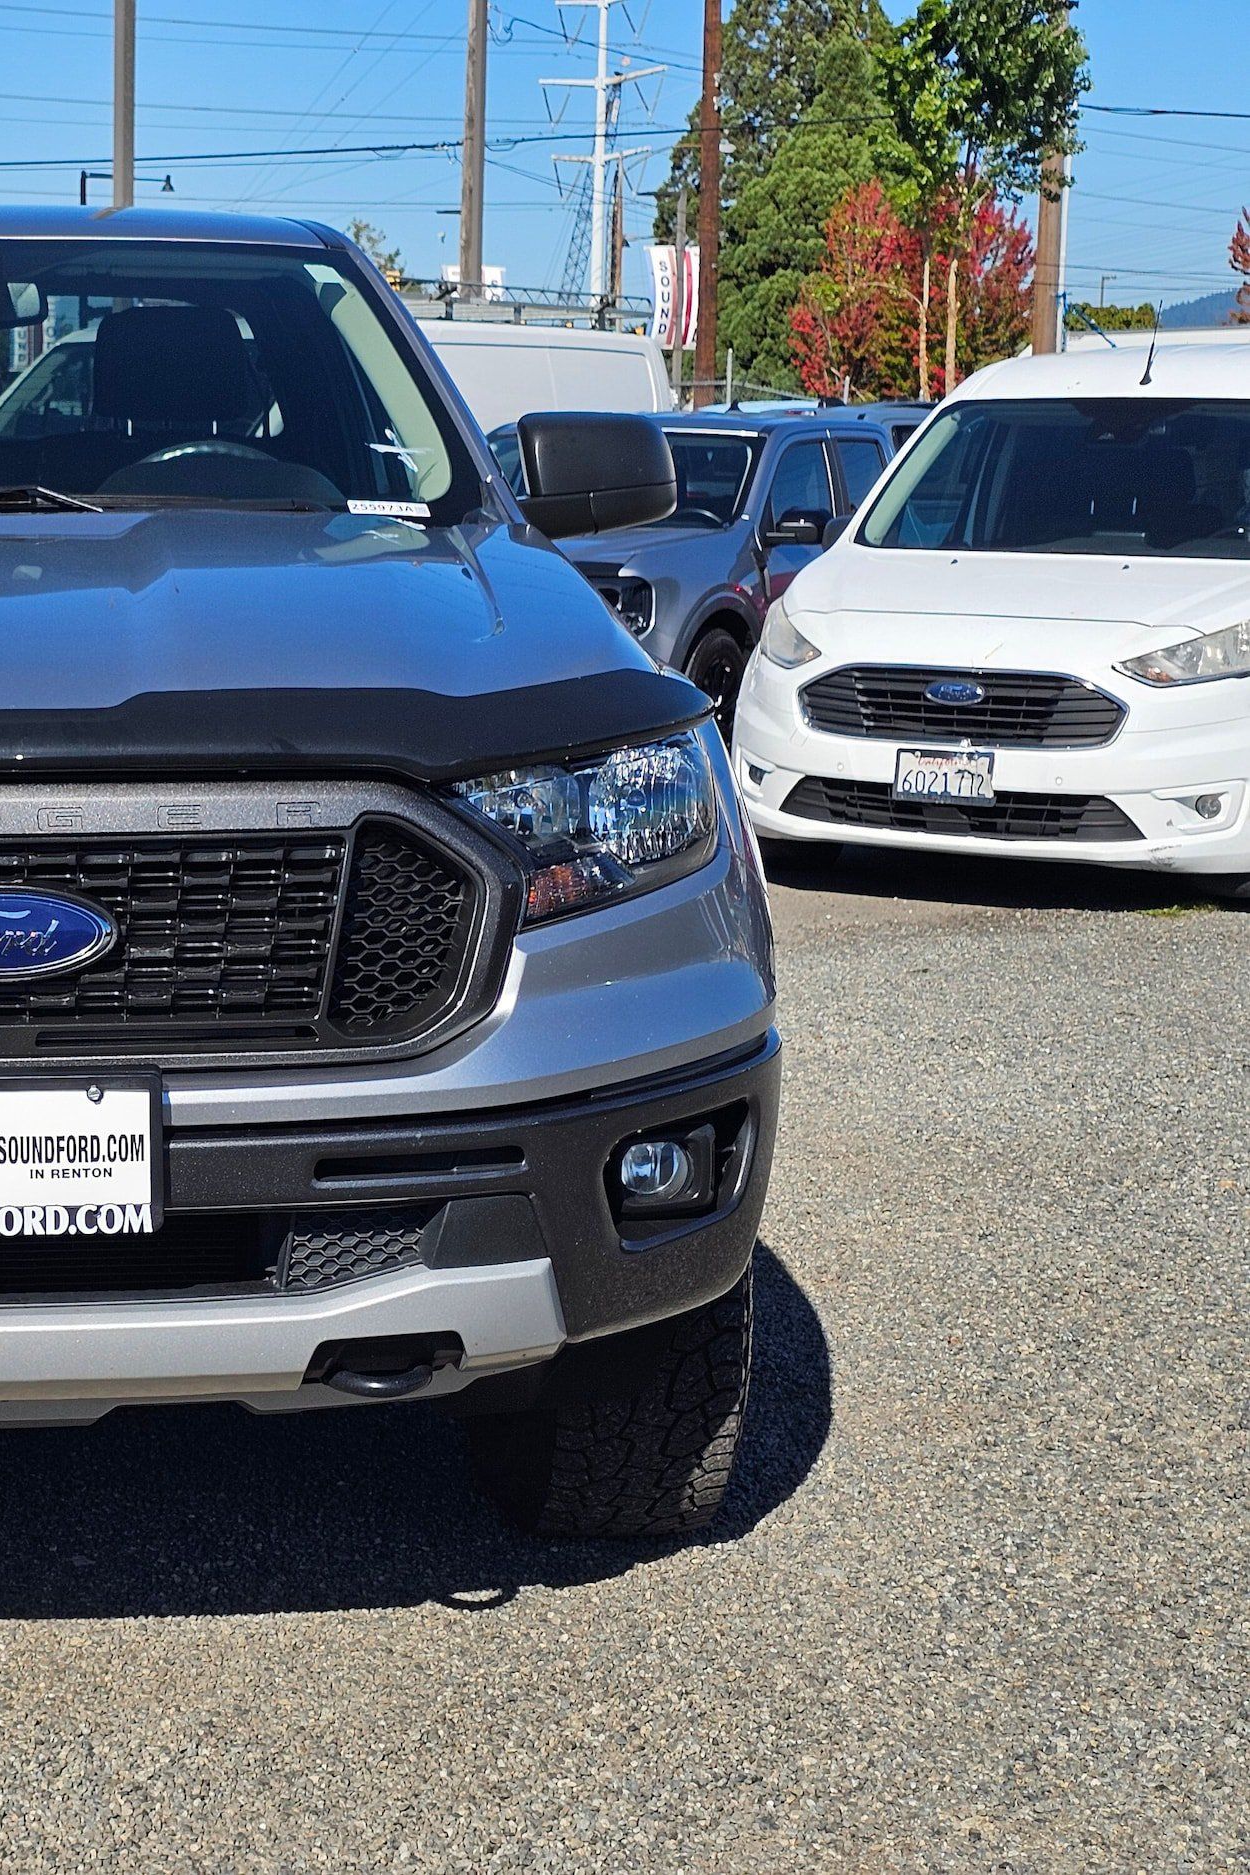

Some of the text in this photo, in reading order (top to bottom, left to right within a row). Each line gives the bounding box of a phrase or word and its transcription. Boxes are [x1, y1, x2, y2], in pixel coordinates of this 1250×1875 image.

[658, 260, 671, 335] SOUND
[29, 1167, 113, 1180] IN RENTON
